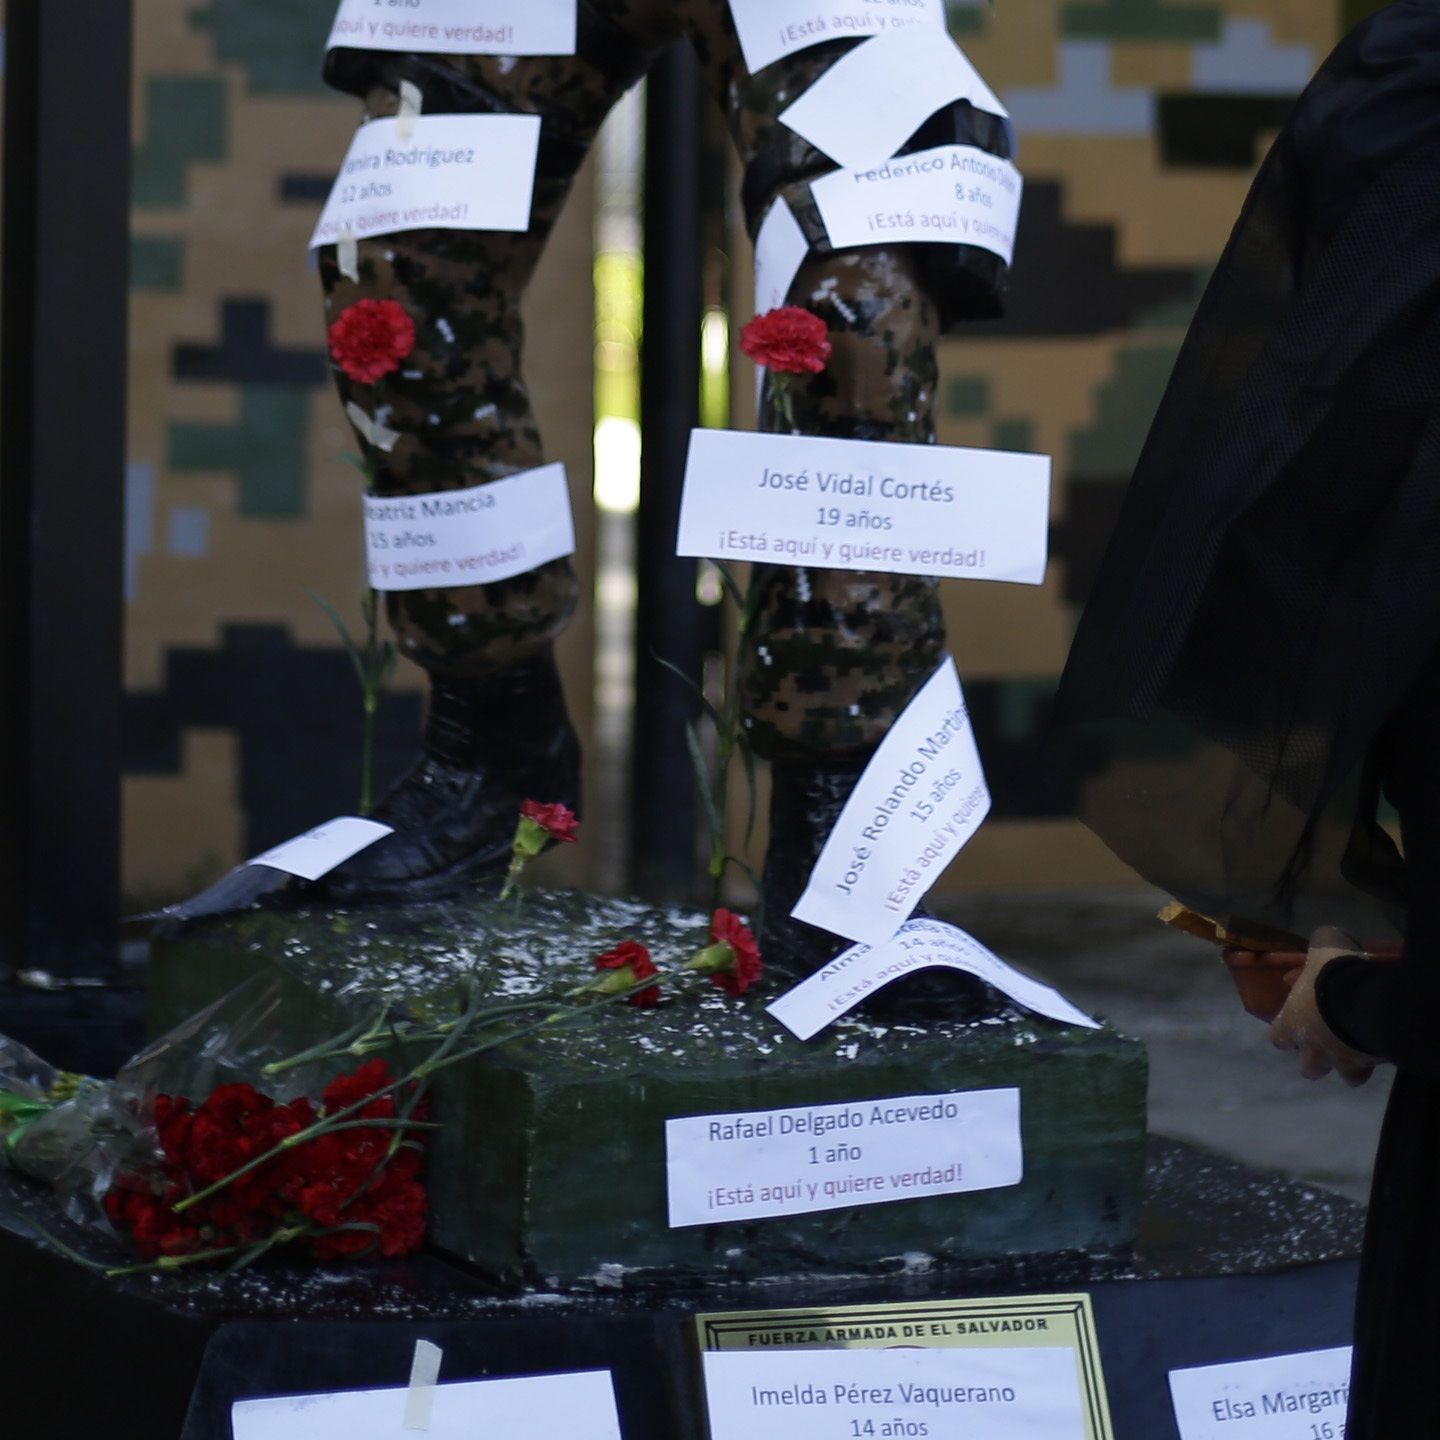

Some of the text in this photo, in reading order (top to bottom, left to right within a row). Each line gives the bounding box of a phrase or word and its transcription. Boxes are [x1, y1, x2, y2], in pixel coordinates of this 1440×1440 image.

[367, 21, 377, 36] y
[383, 19, 439, 39] quiere
[444, 23, 514, 44] verdad!
[780, 18, 827, 47] ¡Está
[832, 12, 872, 31] aquí
[360, 181, 392, 199] años
[955, 183, 965, 201] 8
[402, 203, 469, 222] verdad!
[867, 211, 915, 232] ¡Está
[920, 211, 958, 230] aquí
[961, 215, 969, 233] y
[758, 466, 955, 504] José Vidal Cortés
[366, 504, 416, 522] eatriz
[816, 507, 893, 531] 19 años
[394, 532, 437, 549] años
[718, 531, 987, 569] ¡Está aquí y quiere verdad!
[910, 767, 963, 824] 15 años
[836, 846, 872, 897] José
[862, 760, 926, 842] Rolando
[884, 867, 921, 913] ¡Está
[915, 828, 952, 868] aquí
[941, 822, 958, 838] y
[819, 944, 873, 983] Alma
[828, 977, 873, 1012] ¡Está
[709, 1100, 959, 1142] Rafael Delgado Acevedo
[808, 1143, 862, 1164] 1 año
[708, 1164, 963, 1209] ¡Está aquí y quiere verdad!
[748, 1318, 1048, 1346] FUERZA ARMADA DE EL SALVADOR
[751, 1382, 1016, 1407] Imelda Pérez Vaquerano
[1212, 1383, 1349, 1422] Elsa Margari
[850, 1417, 929, 1438] 14 años
[1309, 1421, 1333, 1440] 16
